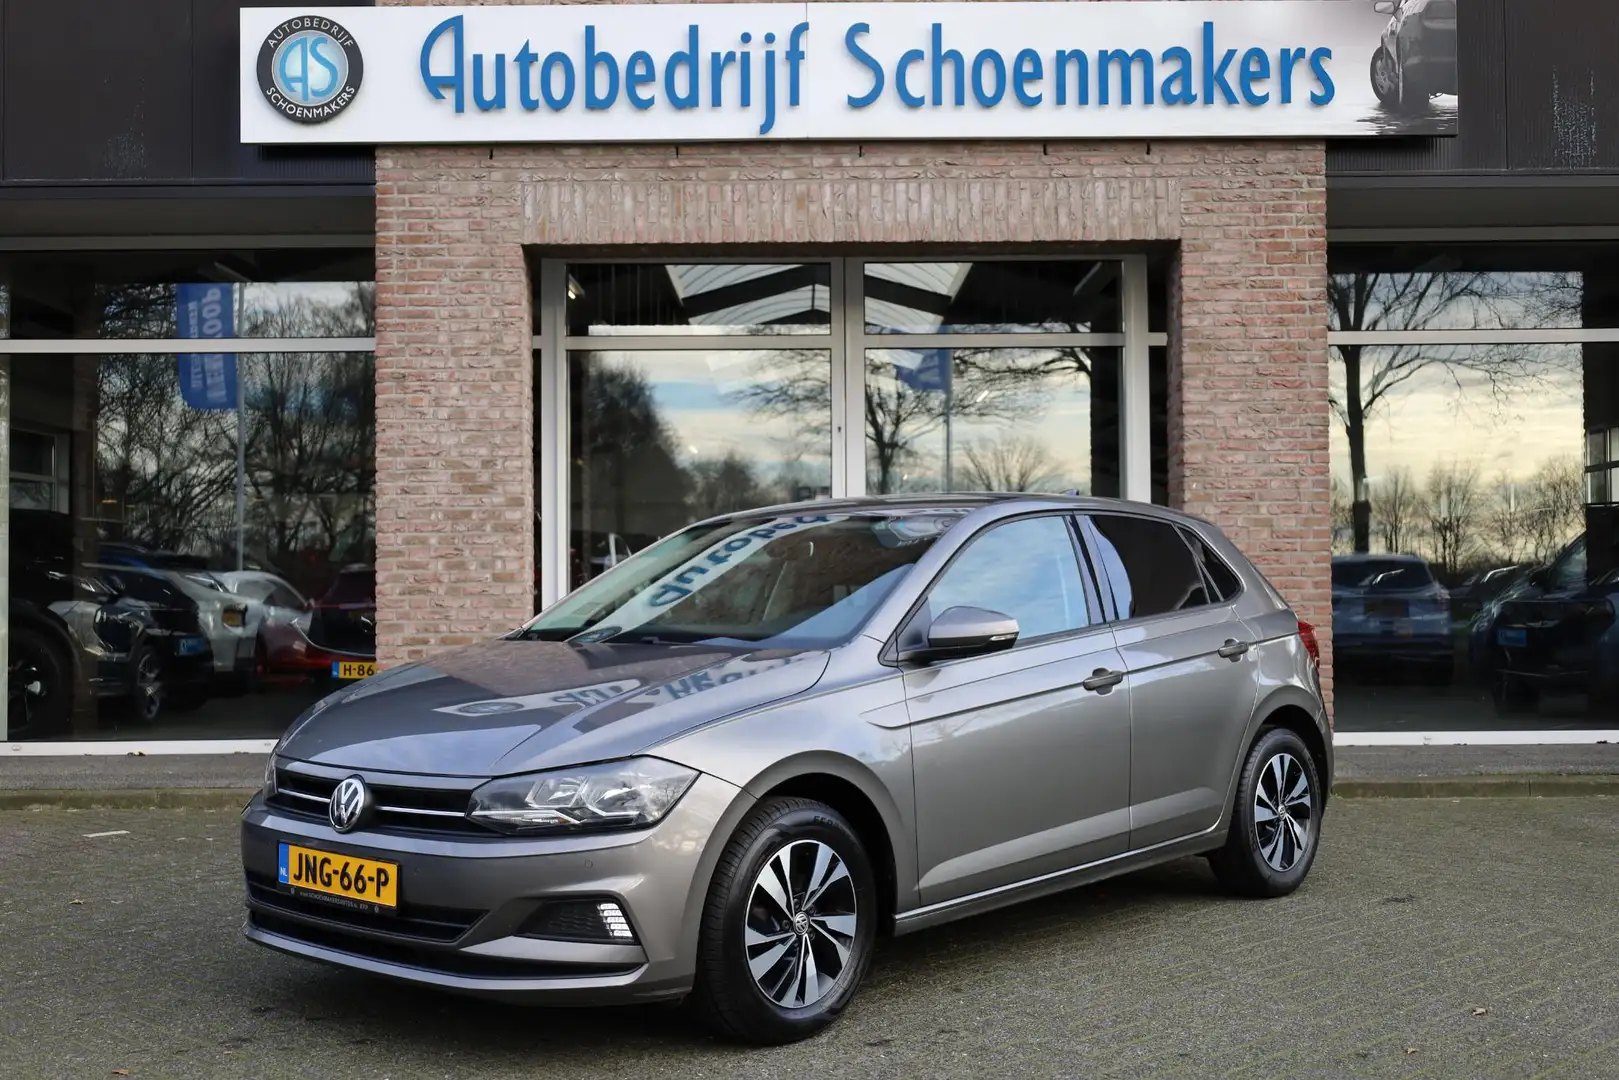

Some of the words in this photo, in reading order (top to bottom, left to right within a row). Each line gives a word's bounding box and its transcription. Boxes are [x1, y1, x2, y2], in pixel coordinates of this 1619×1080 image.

[267, 16, 354, 49] AUTOBEDRIJF
[278, 35, 339, 102] AS
[419, 14, 810, 136] Autobedrijf
[844, 20, 1336, 108] Schoenmakers
[265, 84, 356, 119] SCHOENMAKERS
[279, 866, 288, 877] NL
[293, 852, 390, 898] JNG-66-P
